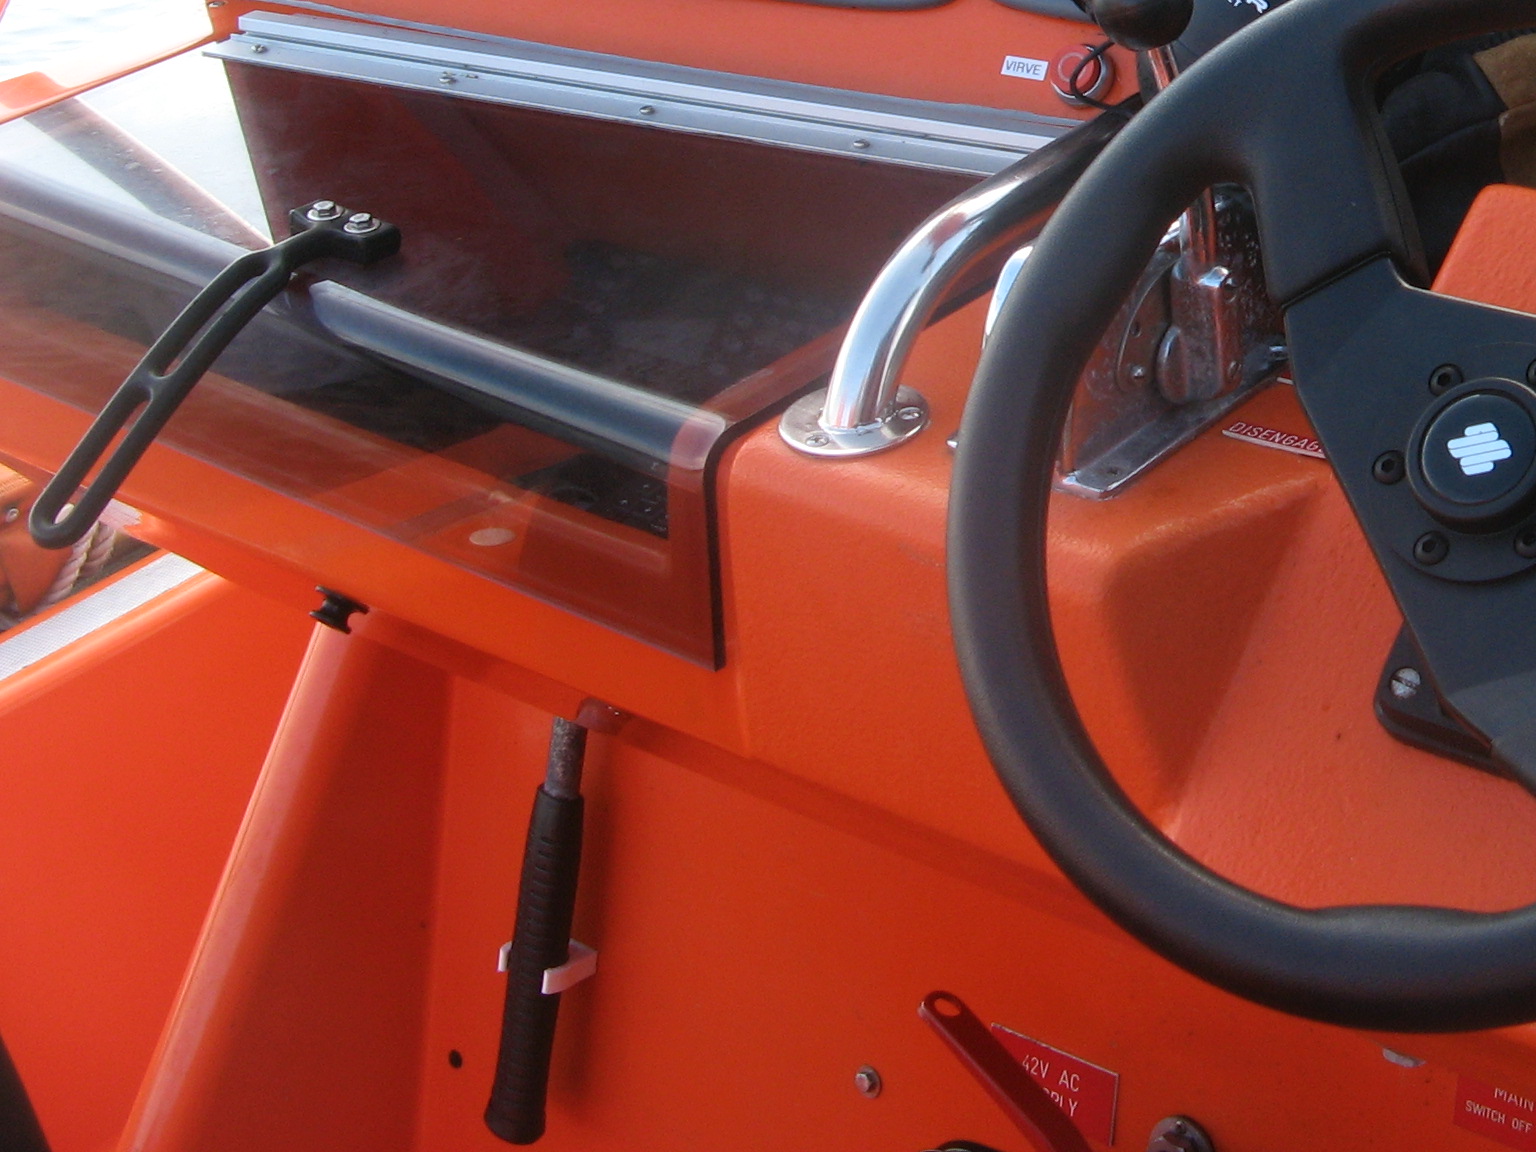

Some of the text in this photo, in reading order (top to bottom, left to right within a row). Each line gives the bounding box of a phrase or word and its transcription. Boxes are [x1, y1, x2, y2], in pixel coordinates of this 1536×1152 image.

[1005, 59, 1042, 76] VIRVE
[1229, 421, 1323, 452] DISENGAG
[1022, 1054, 1080, 1092] 42V AC
[1494, 1087, 1534, 1112] MAIN
[1465, 1100, 1506, 1125] SWITCH
[1511, 1117, 1533, 1134] OFF
